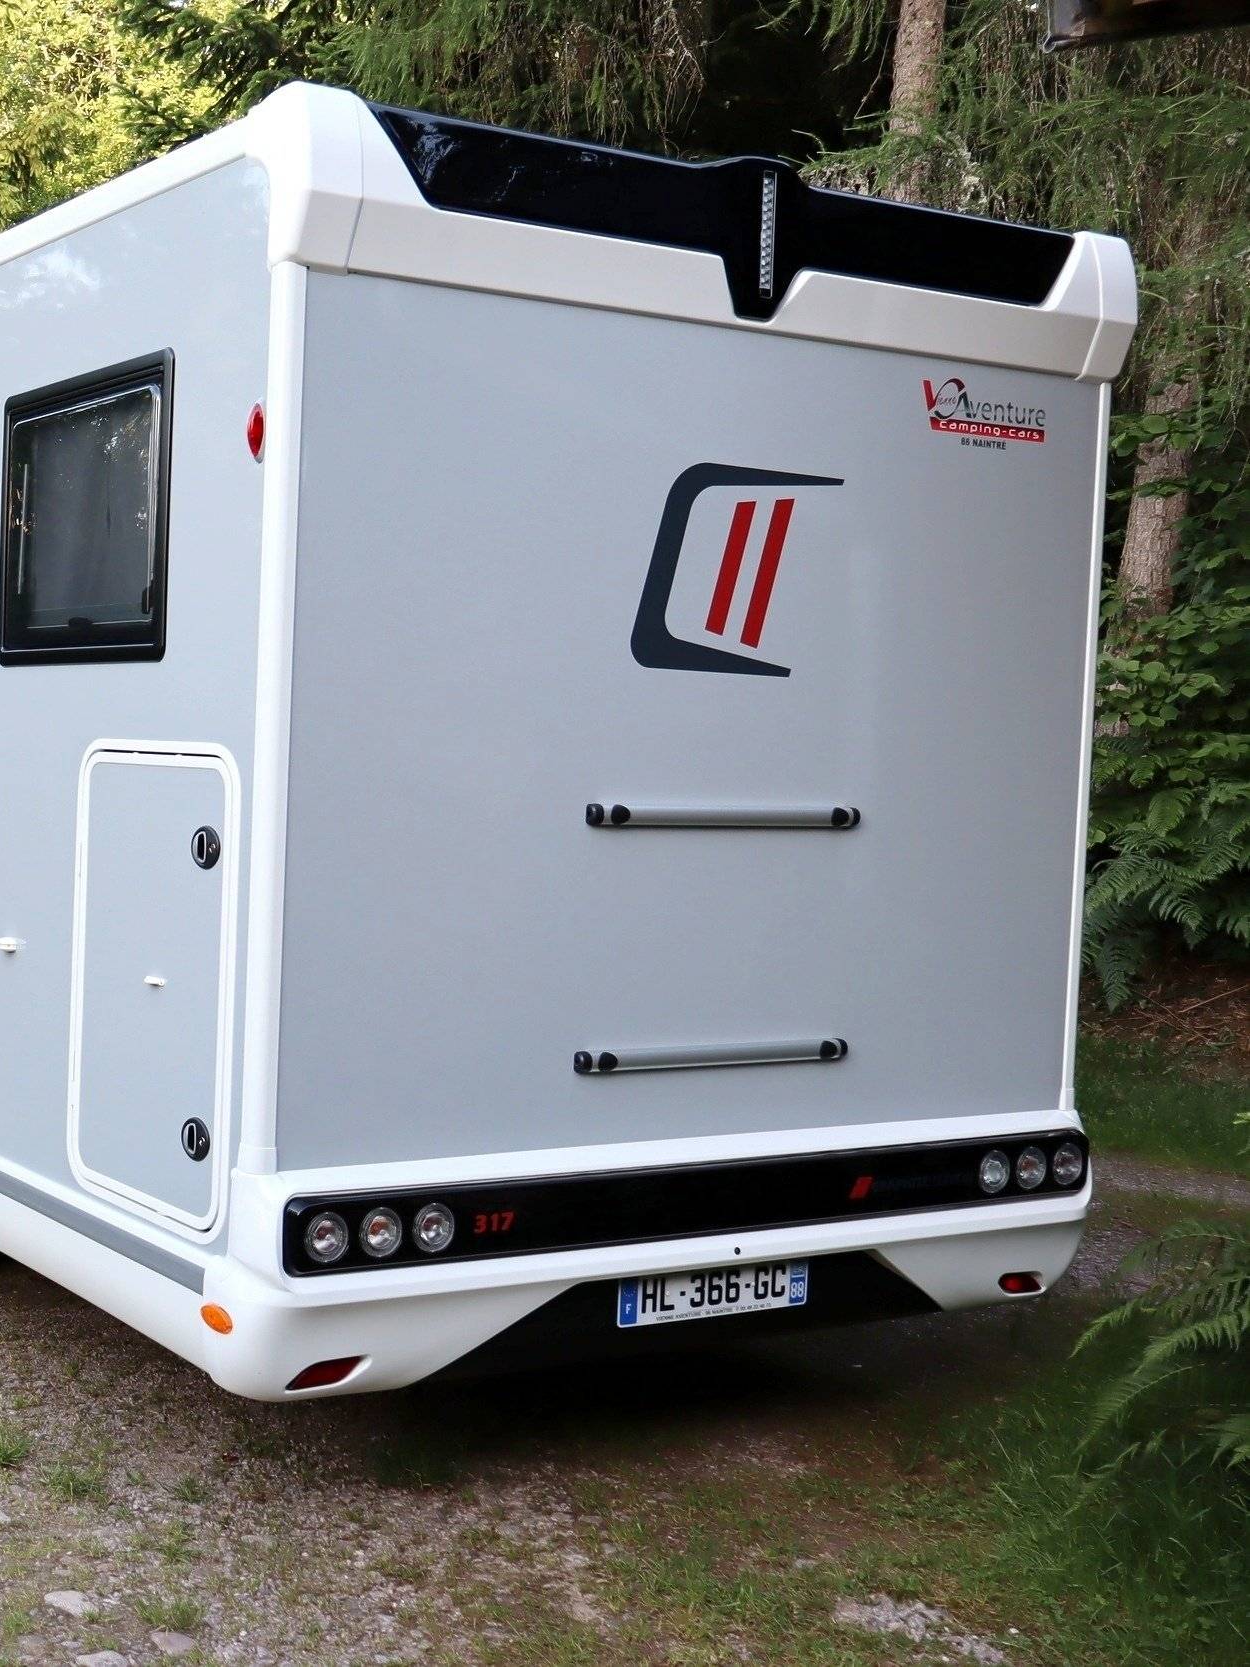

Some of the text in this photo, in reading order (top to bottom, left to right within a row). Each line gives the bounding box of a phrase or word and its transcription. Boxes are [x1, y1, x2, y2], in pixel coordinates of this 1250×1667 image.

[939, 420, 1040, 440] camping-cars
[473, 1211, 515, 1233] 317
[641, 1263, 787, 1314] HL-366-GC
[790, 1280, 805, 1299] 88
[625, 1303, 632, 1315] F
